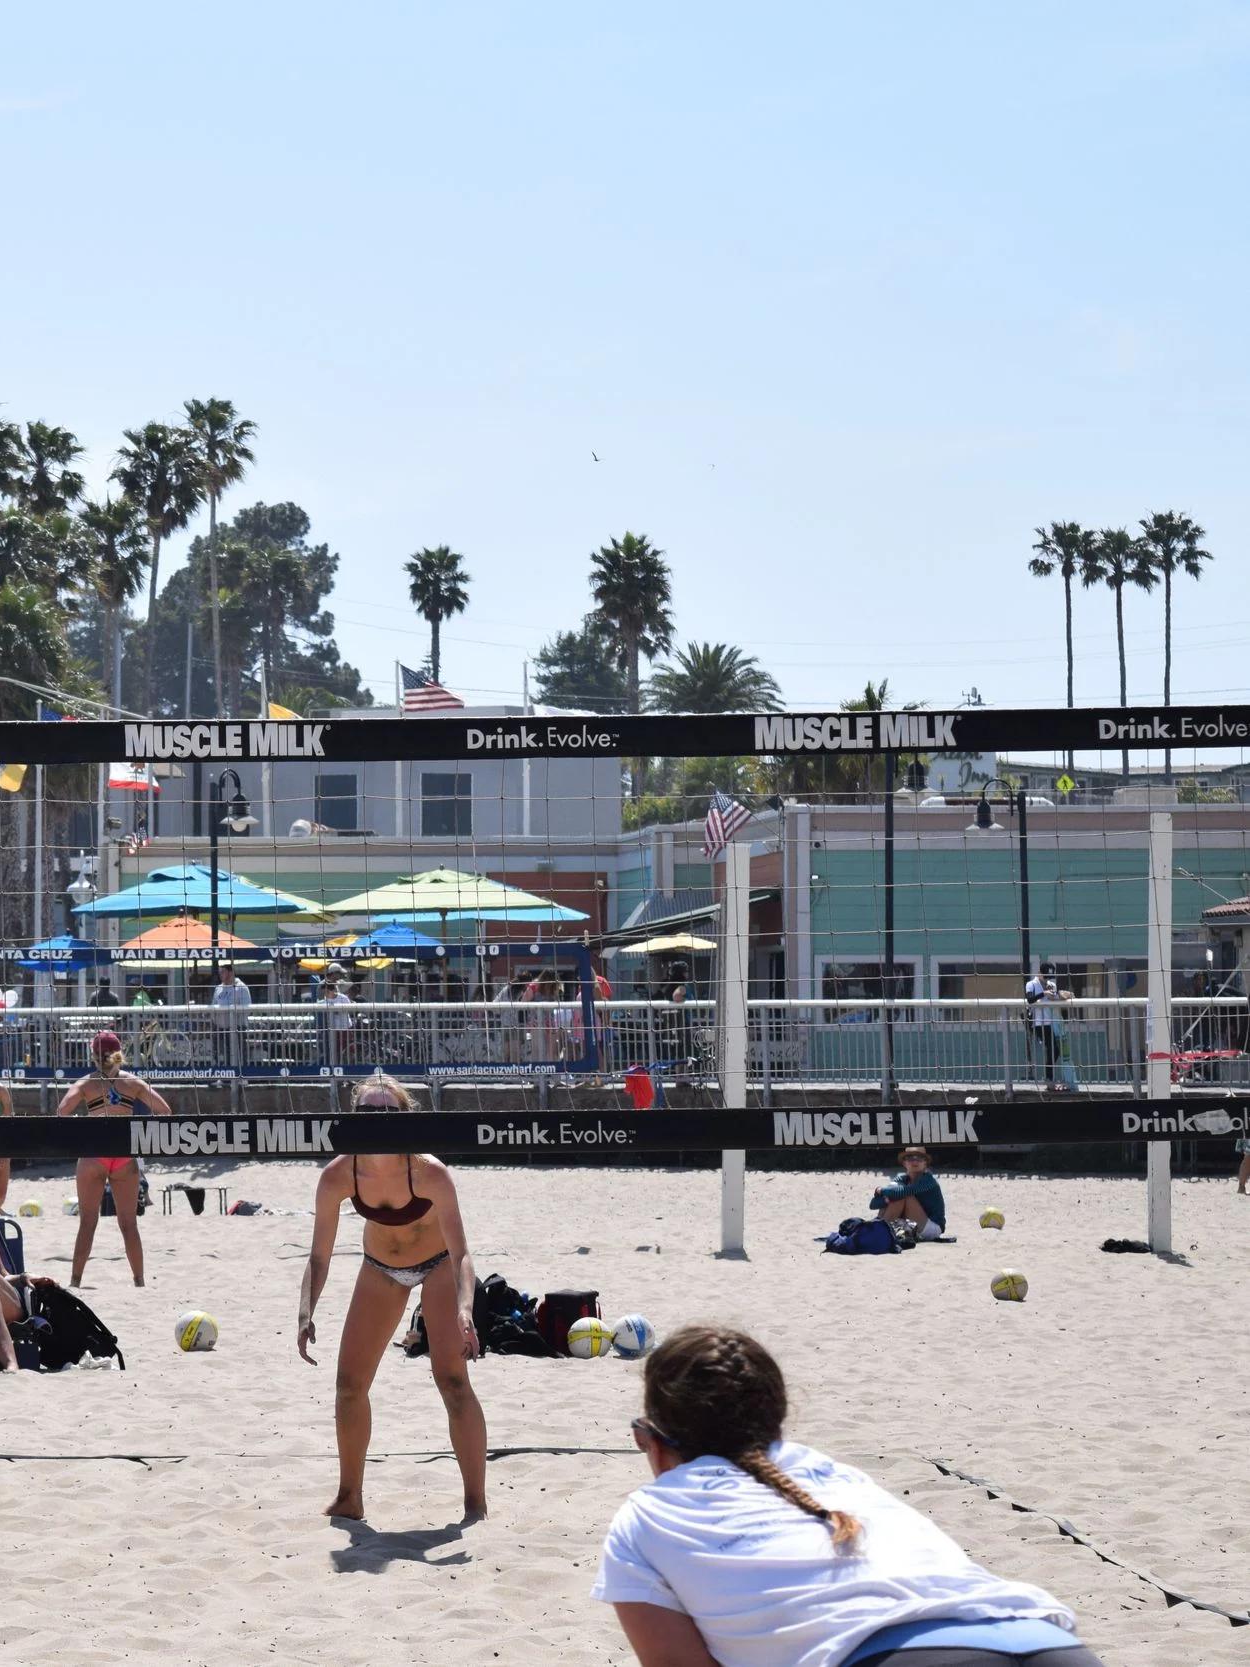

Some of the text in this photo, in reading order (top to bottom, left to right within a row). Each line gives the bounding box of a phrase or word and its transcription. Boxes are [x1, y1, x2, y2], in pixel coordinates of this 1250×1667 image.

[466, 726, 543, 749] Drink.
[754, 714, 957, 750] MUSCLE MILK
[1098, 716, 1176, 740] Drink.
[124, 723, 325, 758] MUSCLE MILK
[28, 950, 73, 960] CRUZ
[110, 949, 157, 959] MAIN
[164, 949, 227, 959] BEACH
[269, 947, 387, 958] VOLLEYBALL
[428, 1063, 556, 1075] www.santacruzwharf.com
[130, 1119, 334, 1154] MUSCLE MILK
[477, 1122, 555, 1145] Drink.
[773, 1110, 979, 1146] MUSCLE MILK
